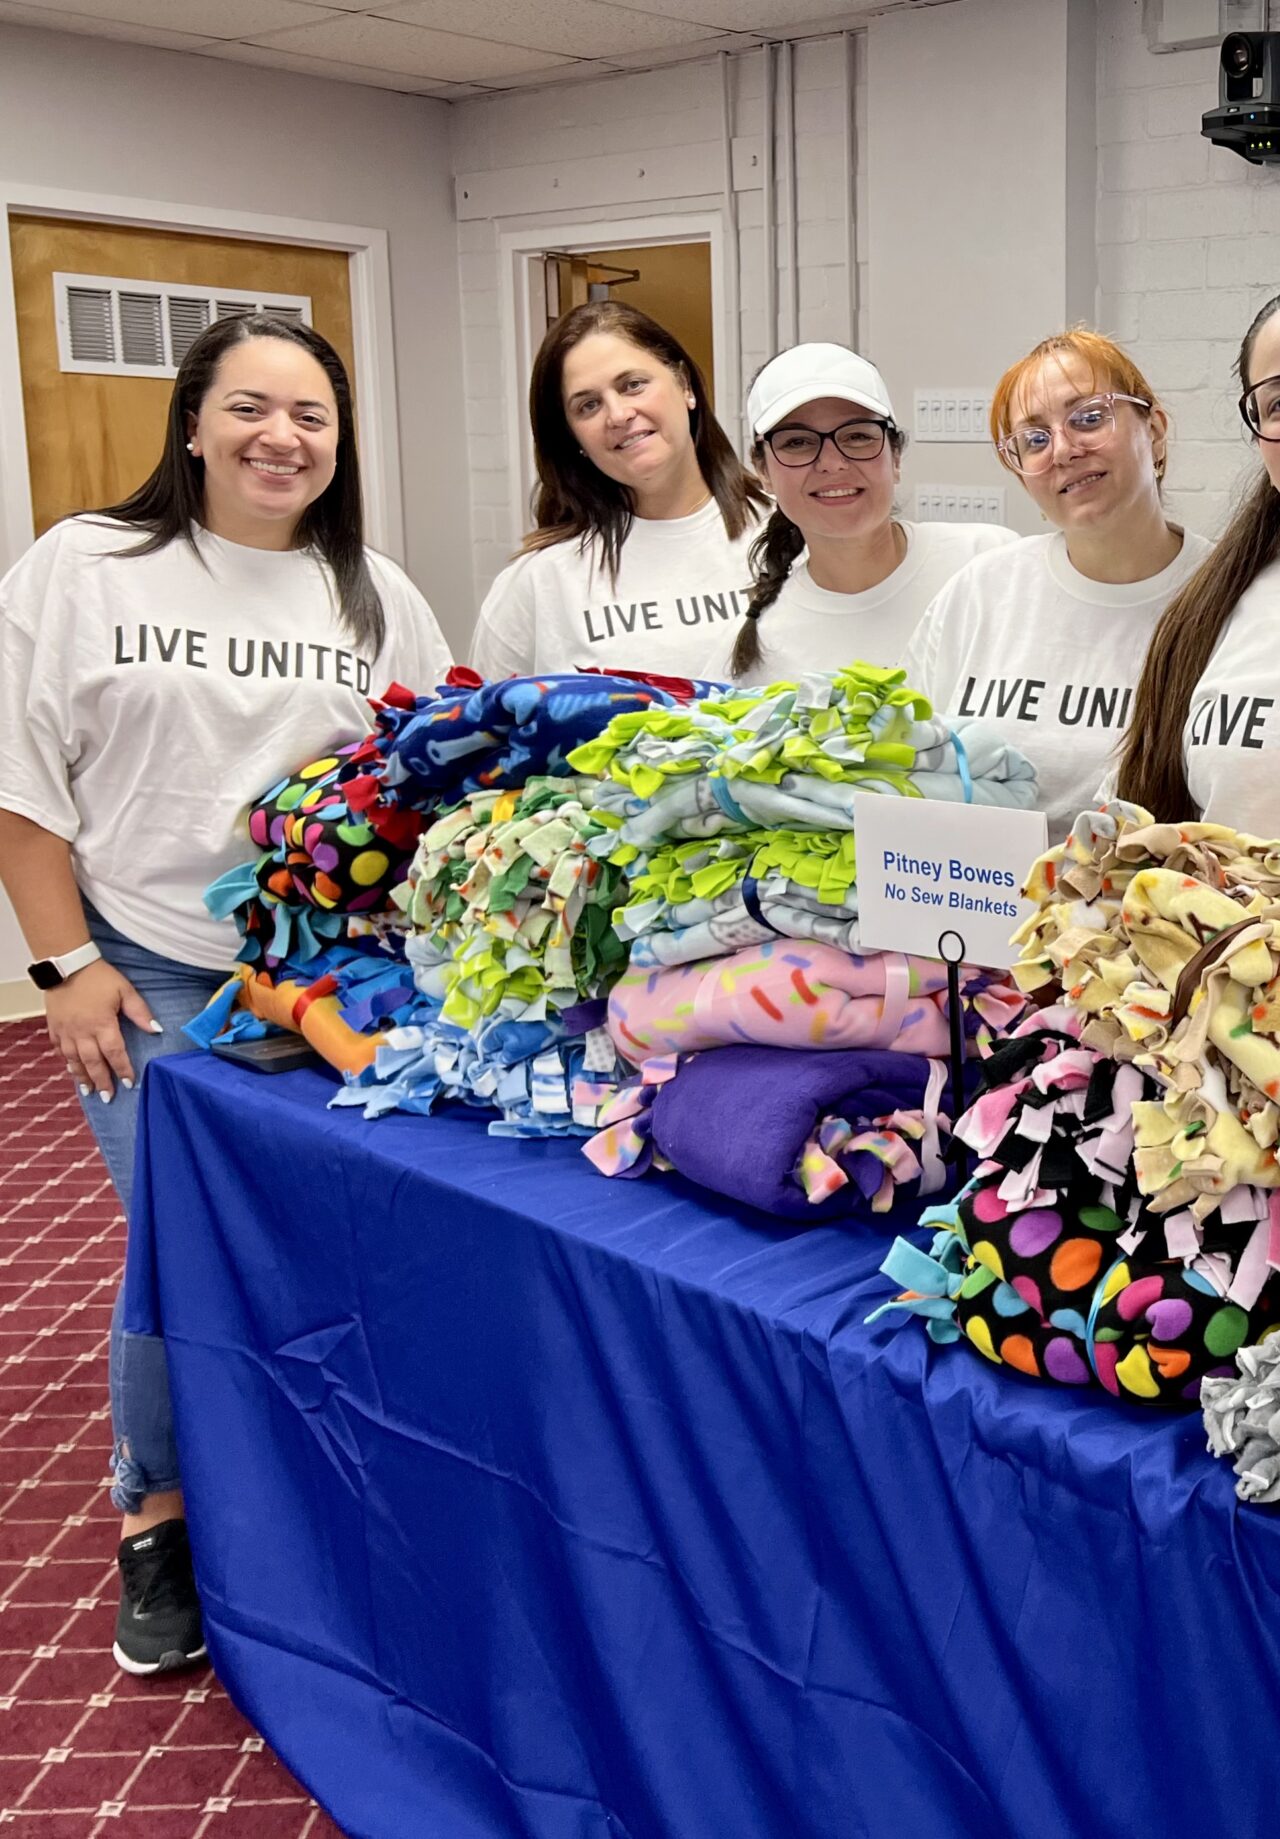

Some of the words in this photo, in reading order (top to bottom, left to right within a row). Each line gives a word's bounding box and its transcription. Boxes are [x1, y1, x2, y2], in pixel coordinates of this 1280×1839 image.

[583, 601, 663, 643] LIVE
[115, 624, 207, 669] LIVE
[228, 637, 371, 697] UNITED
[958, 676, 1046, 722] LIVE
[1058, 684, 1133, 729] UNI
[1191, 693, 1274, 749] LIVE
[883, 851, 942, 882] Pitney
[949, 859, 1015, 887] Bowes
[885, 883, 906, 901] No
[911, 886, 943, 906] Sew
[948, 891, 1017, 917] Blankets
